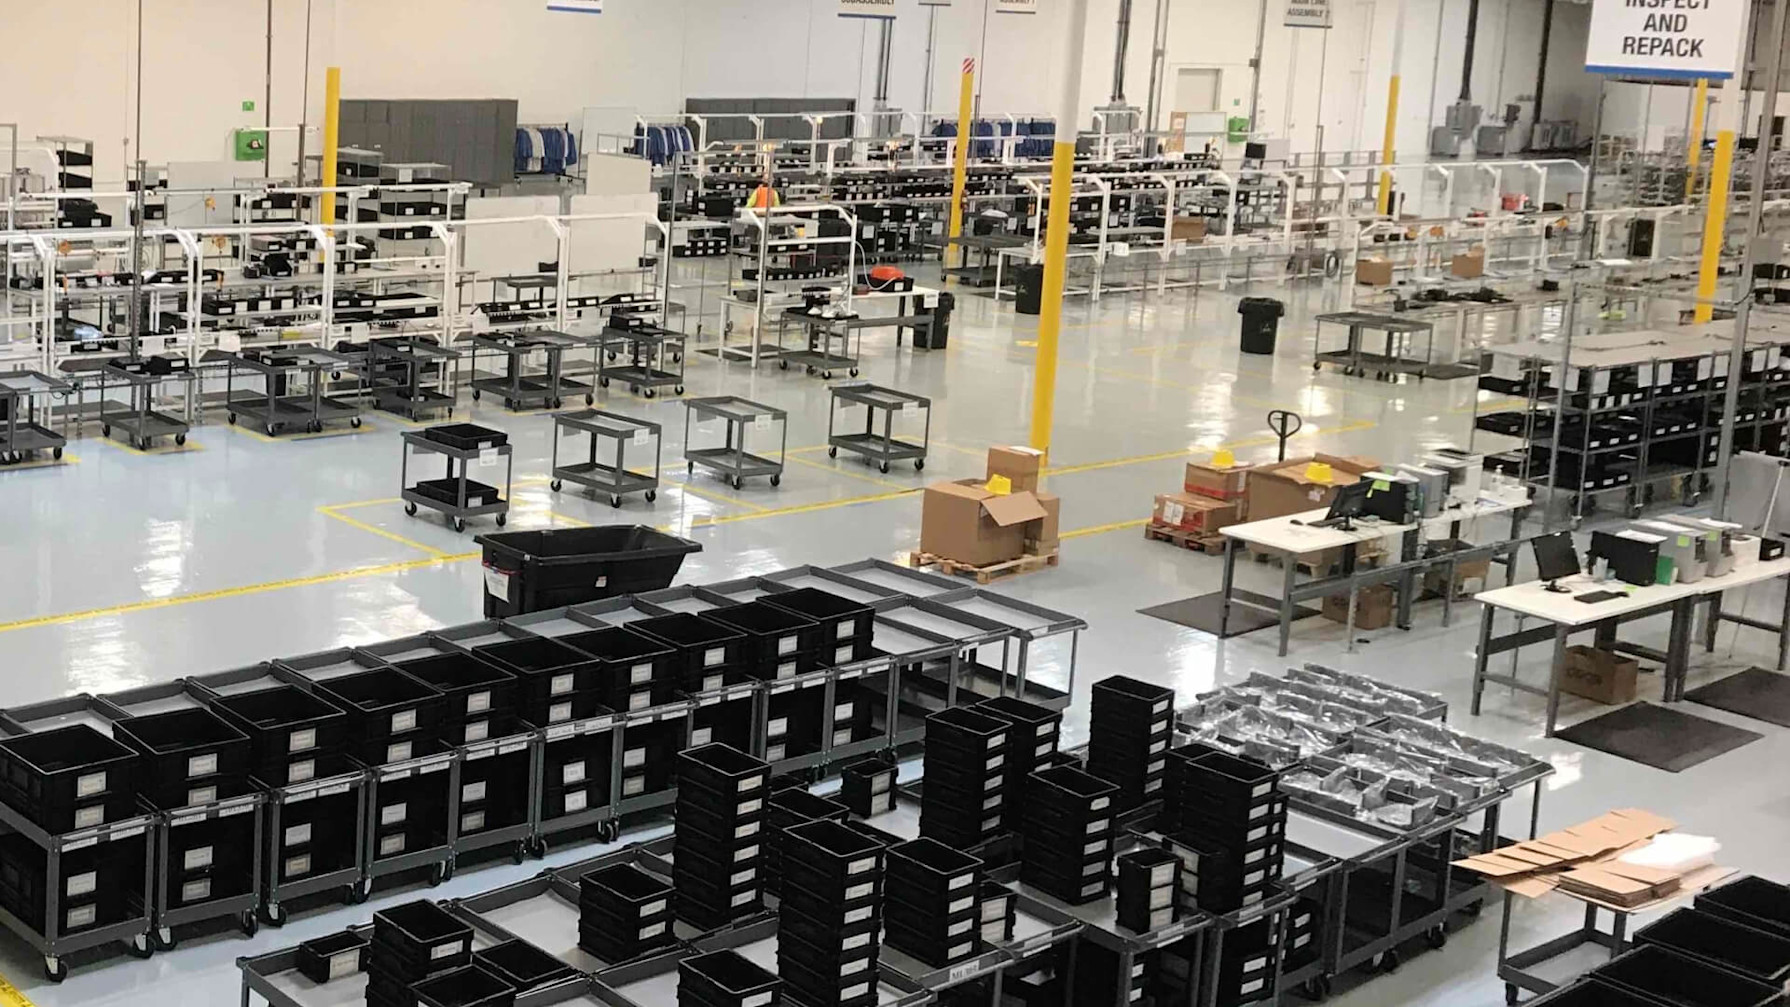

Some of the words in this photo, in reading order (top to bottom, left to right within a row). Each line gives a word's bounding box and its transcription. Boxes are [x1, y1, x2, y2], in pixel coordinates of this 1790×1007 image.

[1287, 8, 1323, 17] ASSEMBLY
[1643, 13, 1688, 33] AND
[1622, 36, 1704, 58] REPACK
